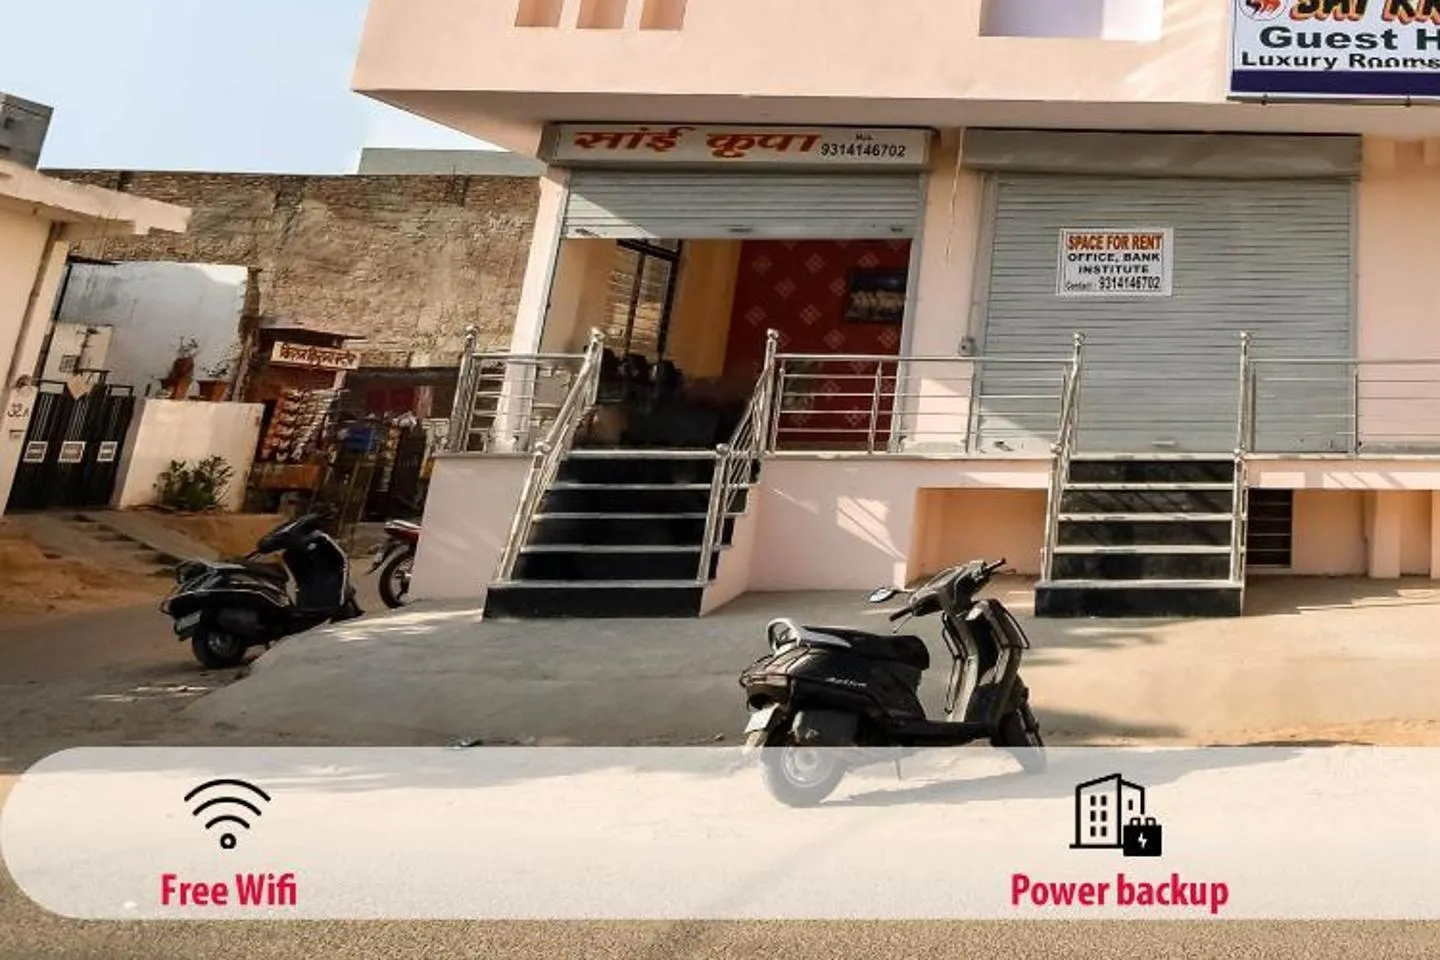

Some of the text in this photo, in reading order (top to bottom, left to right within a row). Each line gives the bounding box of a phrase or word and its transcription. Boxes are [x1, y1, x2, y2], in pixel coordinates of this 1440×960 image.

[1259, 25, 1399, 51] Guest
[1241, 51, 1338, 70] Luxury
[820, 142, 907, 158] 9314146702
[1067, 235, 1162, 250] SPACE FOR RENT
[1123, 252, 1161, 262] BANK
[1078, 264, 1150, 275] INSTITUTE
